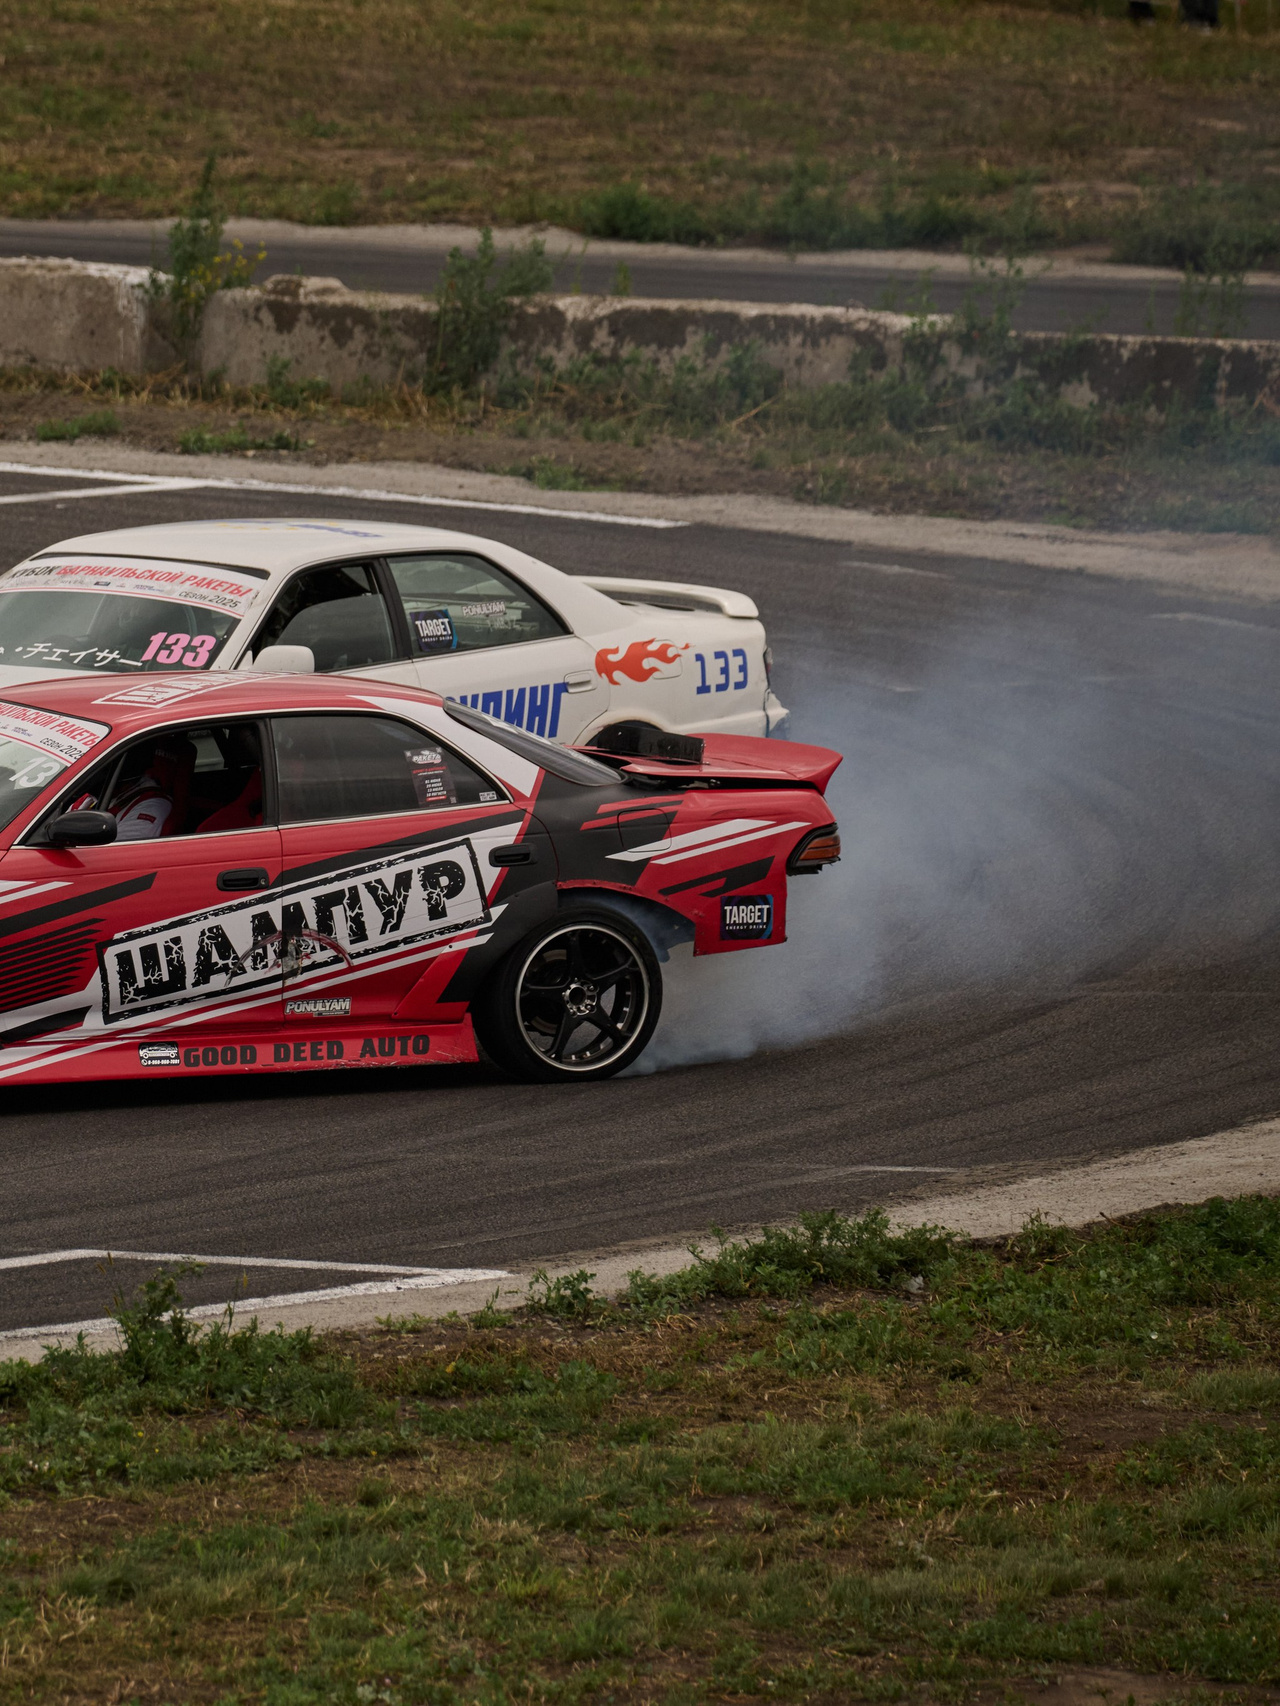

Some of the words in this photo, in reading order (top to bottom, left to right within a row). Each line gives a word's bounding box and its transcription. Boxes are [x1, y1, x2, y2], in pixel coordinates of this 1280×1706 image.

[8, 565, 60, 580] КУБОК
[56, 564, 185, 585] БАРНАУЛЬСКОЙ
[184, 574, 254, 597] РАКЕТЫ
[178, 590, 211, 602] СЕЗОН
[208, 594, 242, 609] 2025
[415, 618, 452, 638] TARGET
[140, 631, 218, 669] 133
[695, 648, 750, 696] 133
[40, 737, 64, 751] СЕЗОН
[724, 905, 770, 924] TARGET
[115, 859, 468, 1007] ШАМПУР
[286, 998, 351, 1014] PONULYAM
